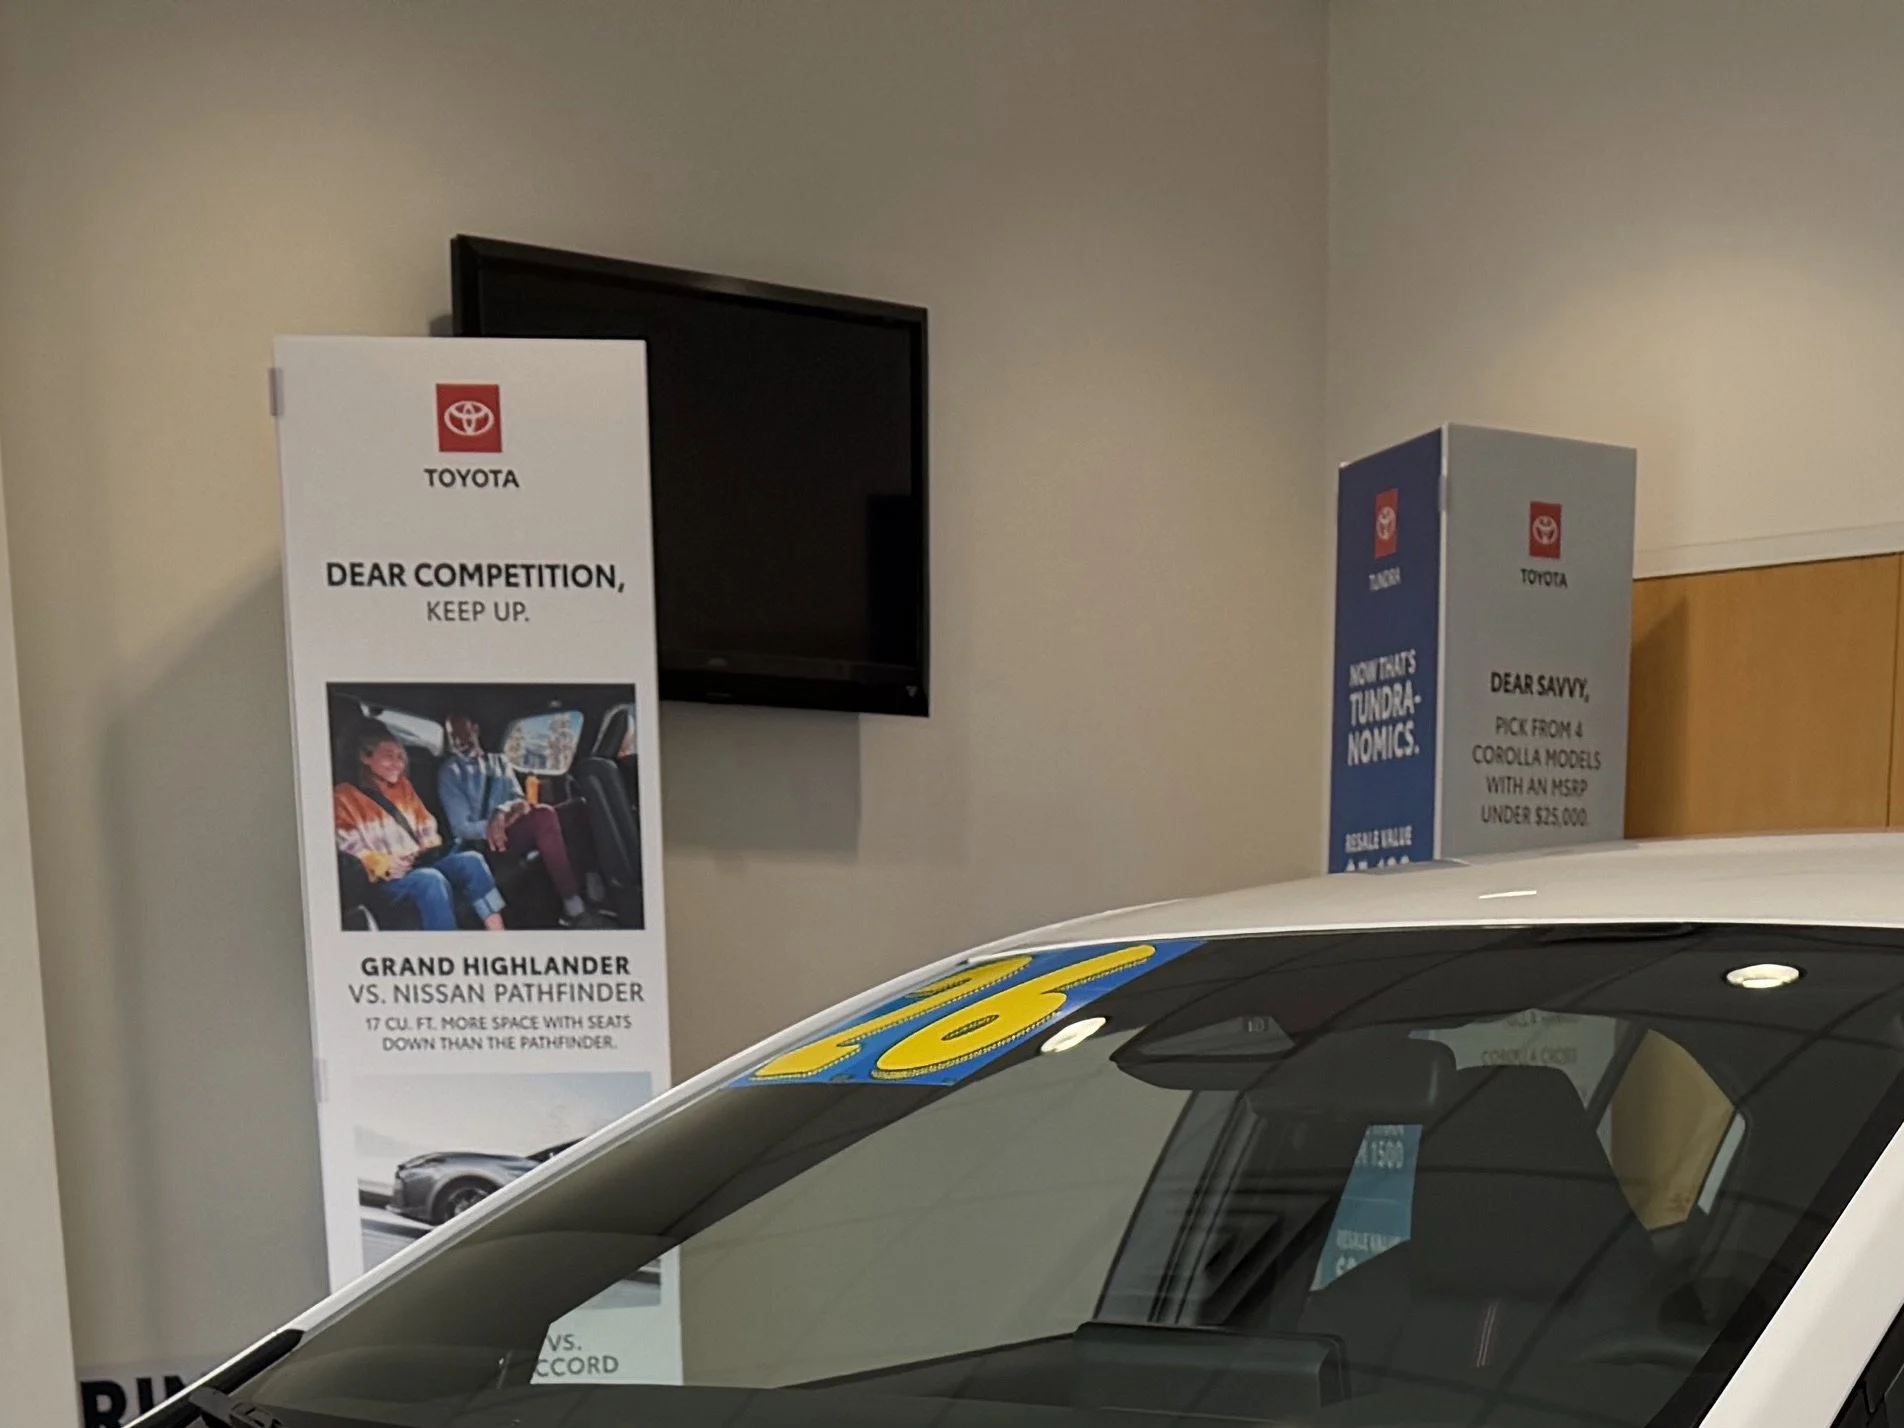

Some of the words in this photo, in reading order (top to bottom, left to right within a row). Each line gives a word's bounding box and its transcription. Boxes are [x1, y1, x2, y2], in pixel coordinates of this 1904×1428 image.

[424, 468, 520, 488] TOYOTA
[326, 562, 406, 587] DEAR
[415, 563, 625, 593] COMPETITION,
[1520, 568, 1568, 589] TOYOTA
[427, 601, 485, 622] KEEP
[494, 602, 530, 623] UP.
[1349, 658, 1378, 688] NOW
[1491, 671, 1533, 695] DEAR
[1537, 674, 1590, 703] SAVVY,
[1349, 680, 1422, 726] TUNDRA-
[1496, 716, 1528, 737] PICK
[1532, 717, 1571, 739] FROM
[1575, 721, 1583, 741] 4
[1347, 720, 1420, 766] NOMICS.
[1471, 743, 1541, 768] COROLLA
[1546, 748, 1601, 771] MODELS
[1486, 776, 1523, 796] WITH
[1527, 777, 1548, 797] AN
[1551, 778, 1588, 798] MSRP
[1480, 804, 1532, 826] UNDER
[361, 957, 455, 976] GRAND
[463, 956, 631, 976] HIGHLANDER
[348, 984, 387, 1004] VS.
[393, 983, 486, 1003] NISSAN
[496, 982, 645, 1002] PATHFINDER
[365, 1016, 380, 1031] 17
[385, 1016, 412, 1031] CU.
[416, 1016, 437, 1031] FT.
[442, 1016, 487, 1030] MORE
[492, 1015, 539, 1030] SPACE
[542, 1014, 583, 1030] WITH
[587, 1014, 632, 1029] SEATS
[382, 1036, 435, 1051] DOWN
[439, 1036, 484, 1050] THAN
[487, 1036, 516, 1050] THE
[520, 1035, 618, 1050] PATHFINDER.
[547, 1333, 582, 1352] VS.
[536, 1355, 619, 1377] CCORD
